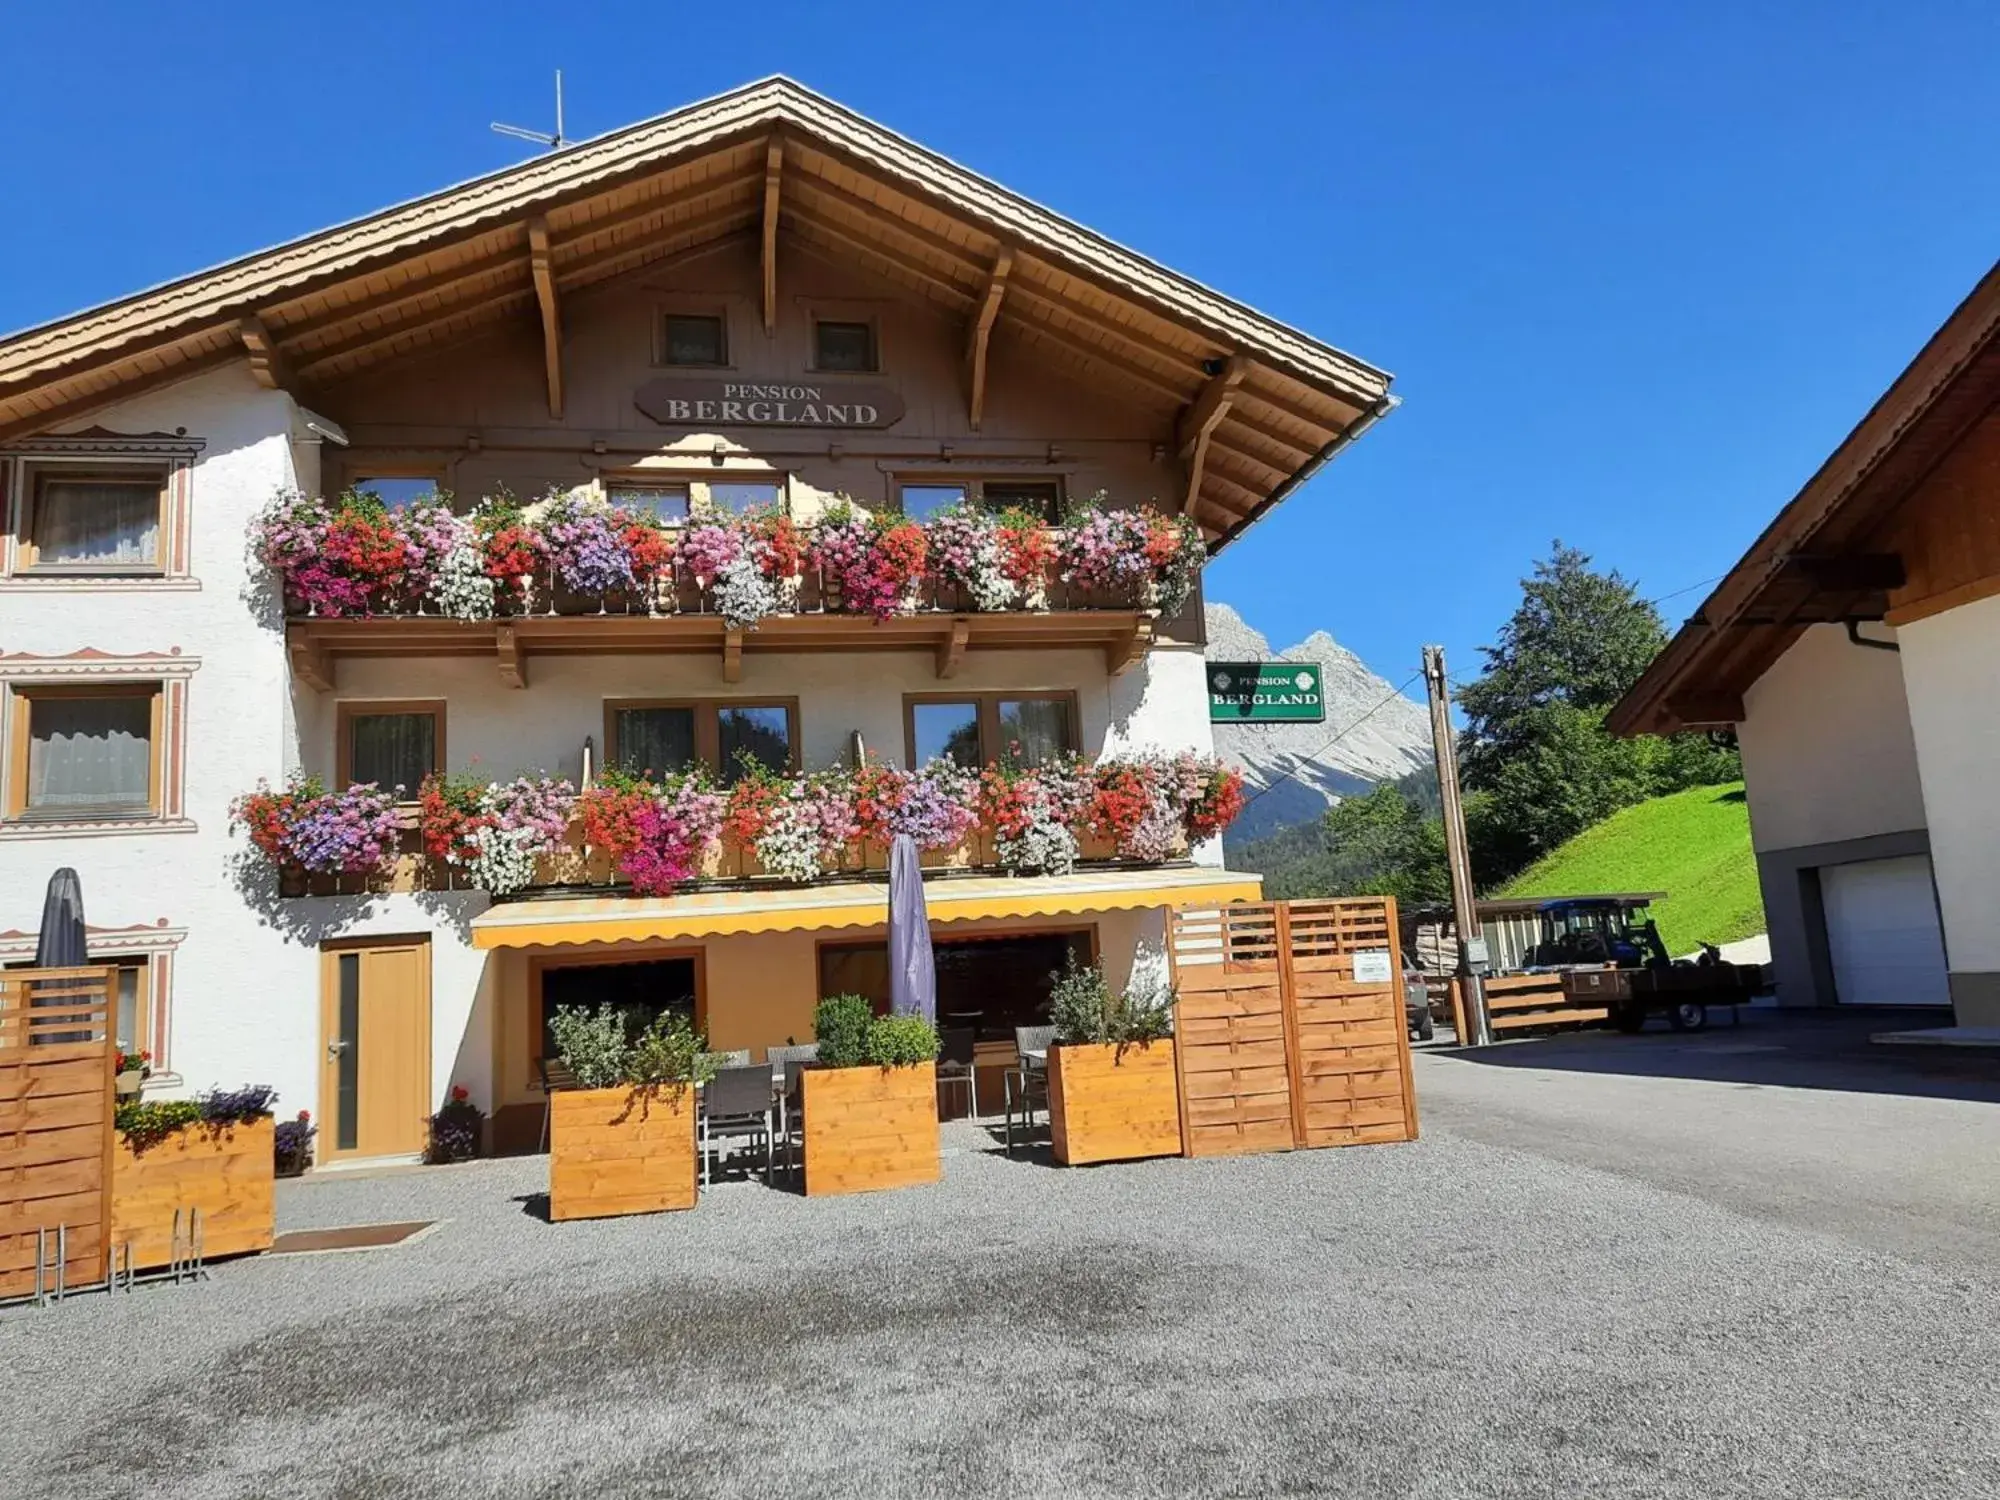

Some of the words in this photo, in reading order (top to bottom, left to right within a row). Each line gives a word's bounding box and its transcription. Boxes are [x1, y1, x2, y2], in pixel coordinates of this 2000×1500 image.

[723, 383, 822, 400] PENSION
[667, 400, 878, 424] BERGLAND
[1239, 676, 1291, 686] PENSION
[1213, 693, 1319, 705] BERGLAND
